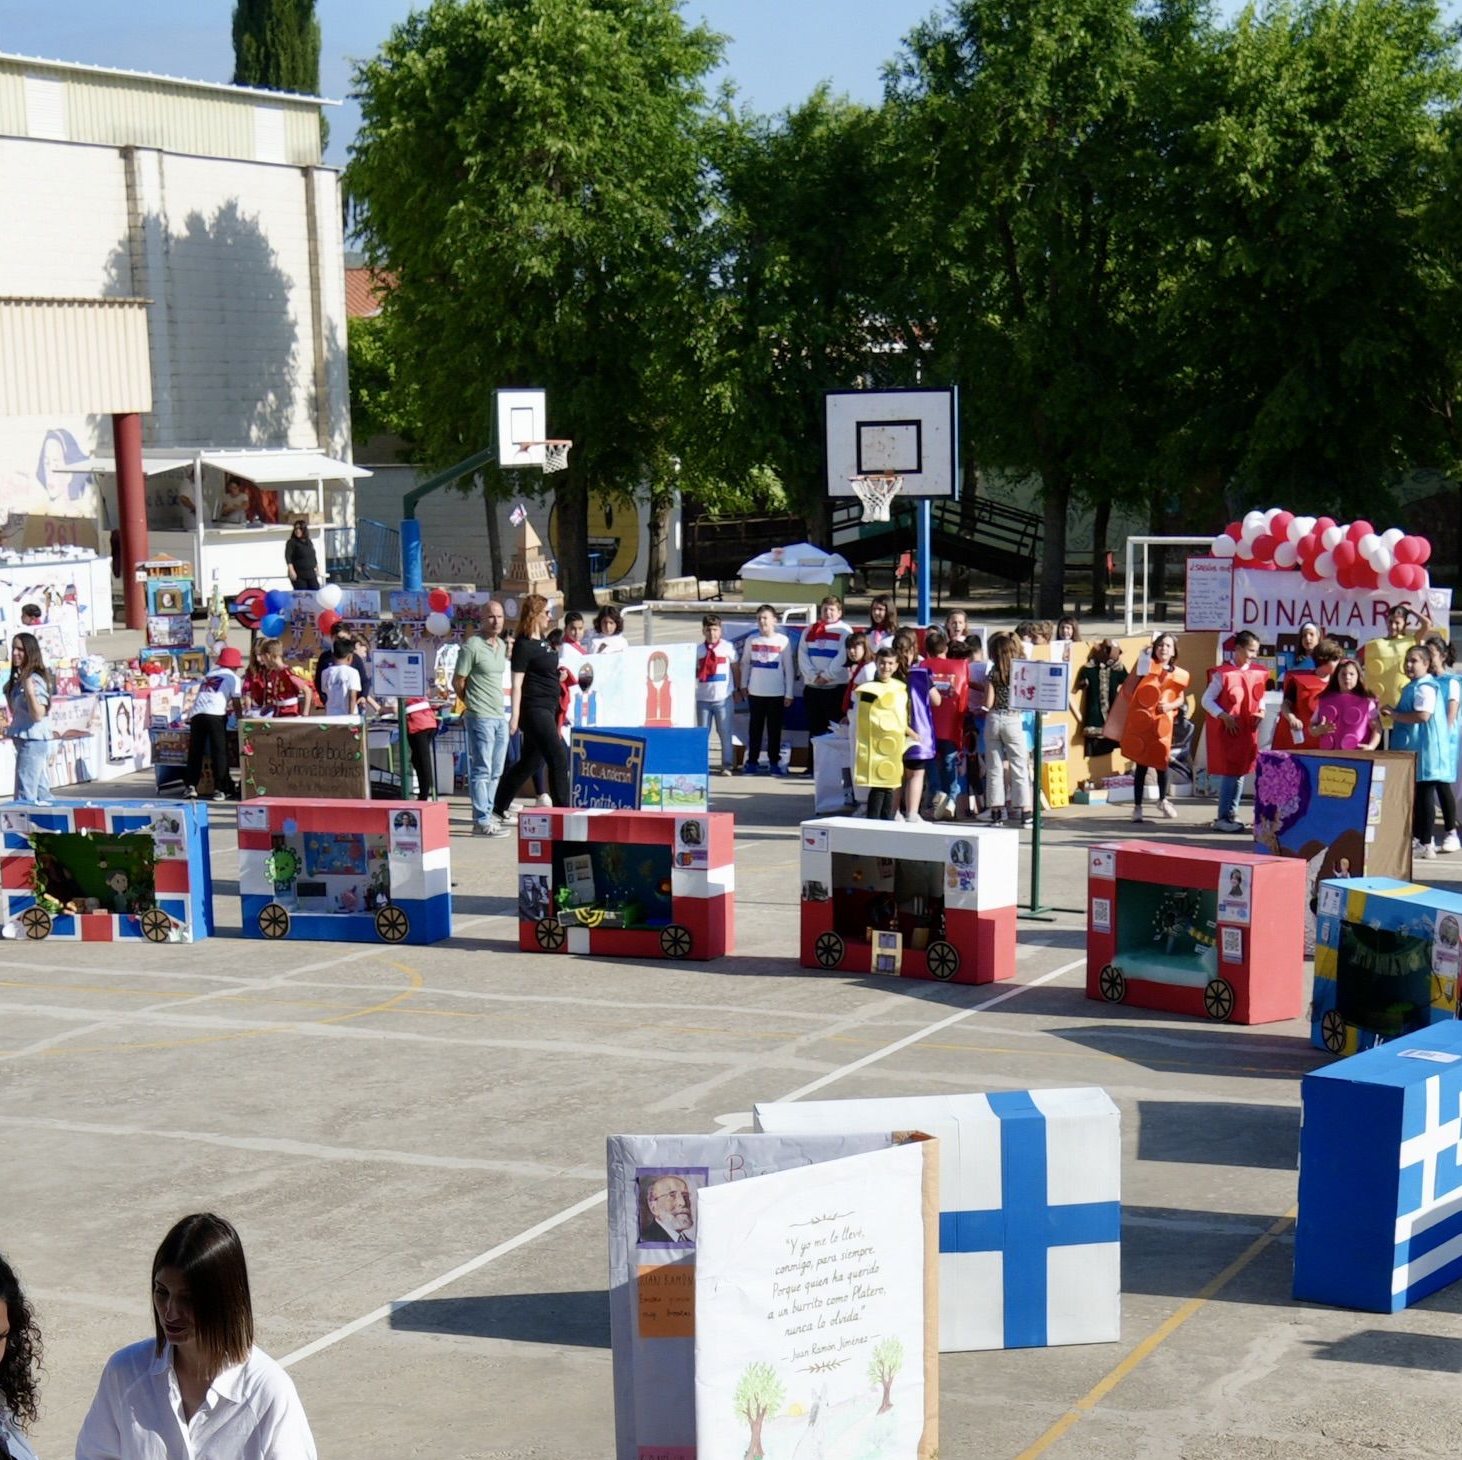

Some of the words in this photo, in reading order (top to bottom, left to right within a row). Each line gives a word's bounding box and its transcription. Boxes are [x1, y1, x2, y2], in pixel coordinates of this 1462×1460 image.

[800, 1241, 811, 1257] yo
[814, 1237, 826, 1247] me
[830, 1229, 839, 1244] lo
[816, 1254, 837, 1271] para
[773, 1282, 802, 1304] Porque
[805, 1277, 829, 1295] quien
[832, 1269, 844, 1283] ha
[847, 1259, 880, 1285] querido
[767, 1311, 775, 1320] a
[778, 1308, 789, 1317] un
[792, 1299, 824, 1314] burrito
[826, 1294, 849, 1306] como
[784, 1322, 814, 1337] nunca
[817, 1314, 826, 1329] lo
[791, 1348, 810, 1363] Juan
